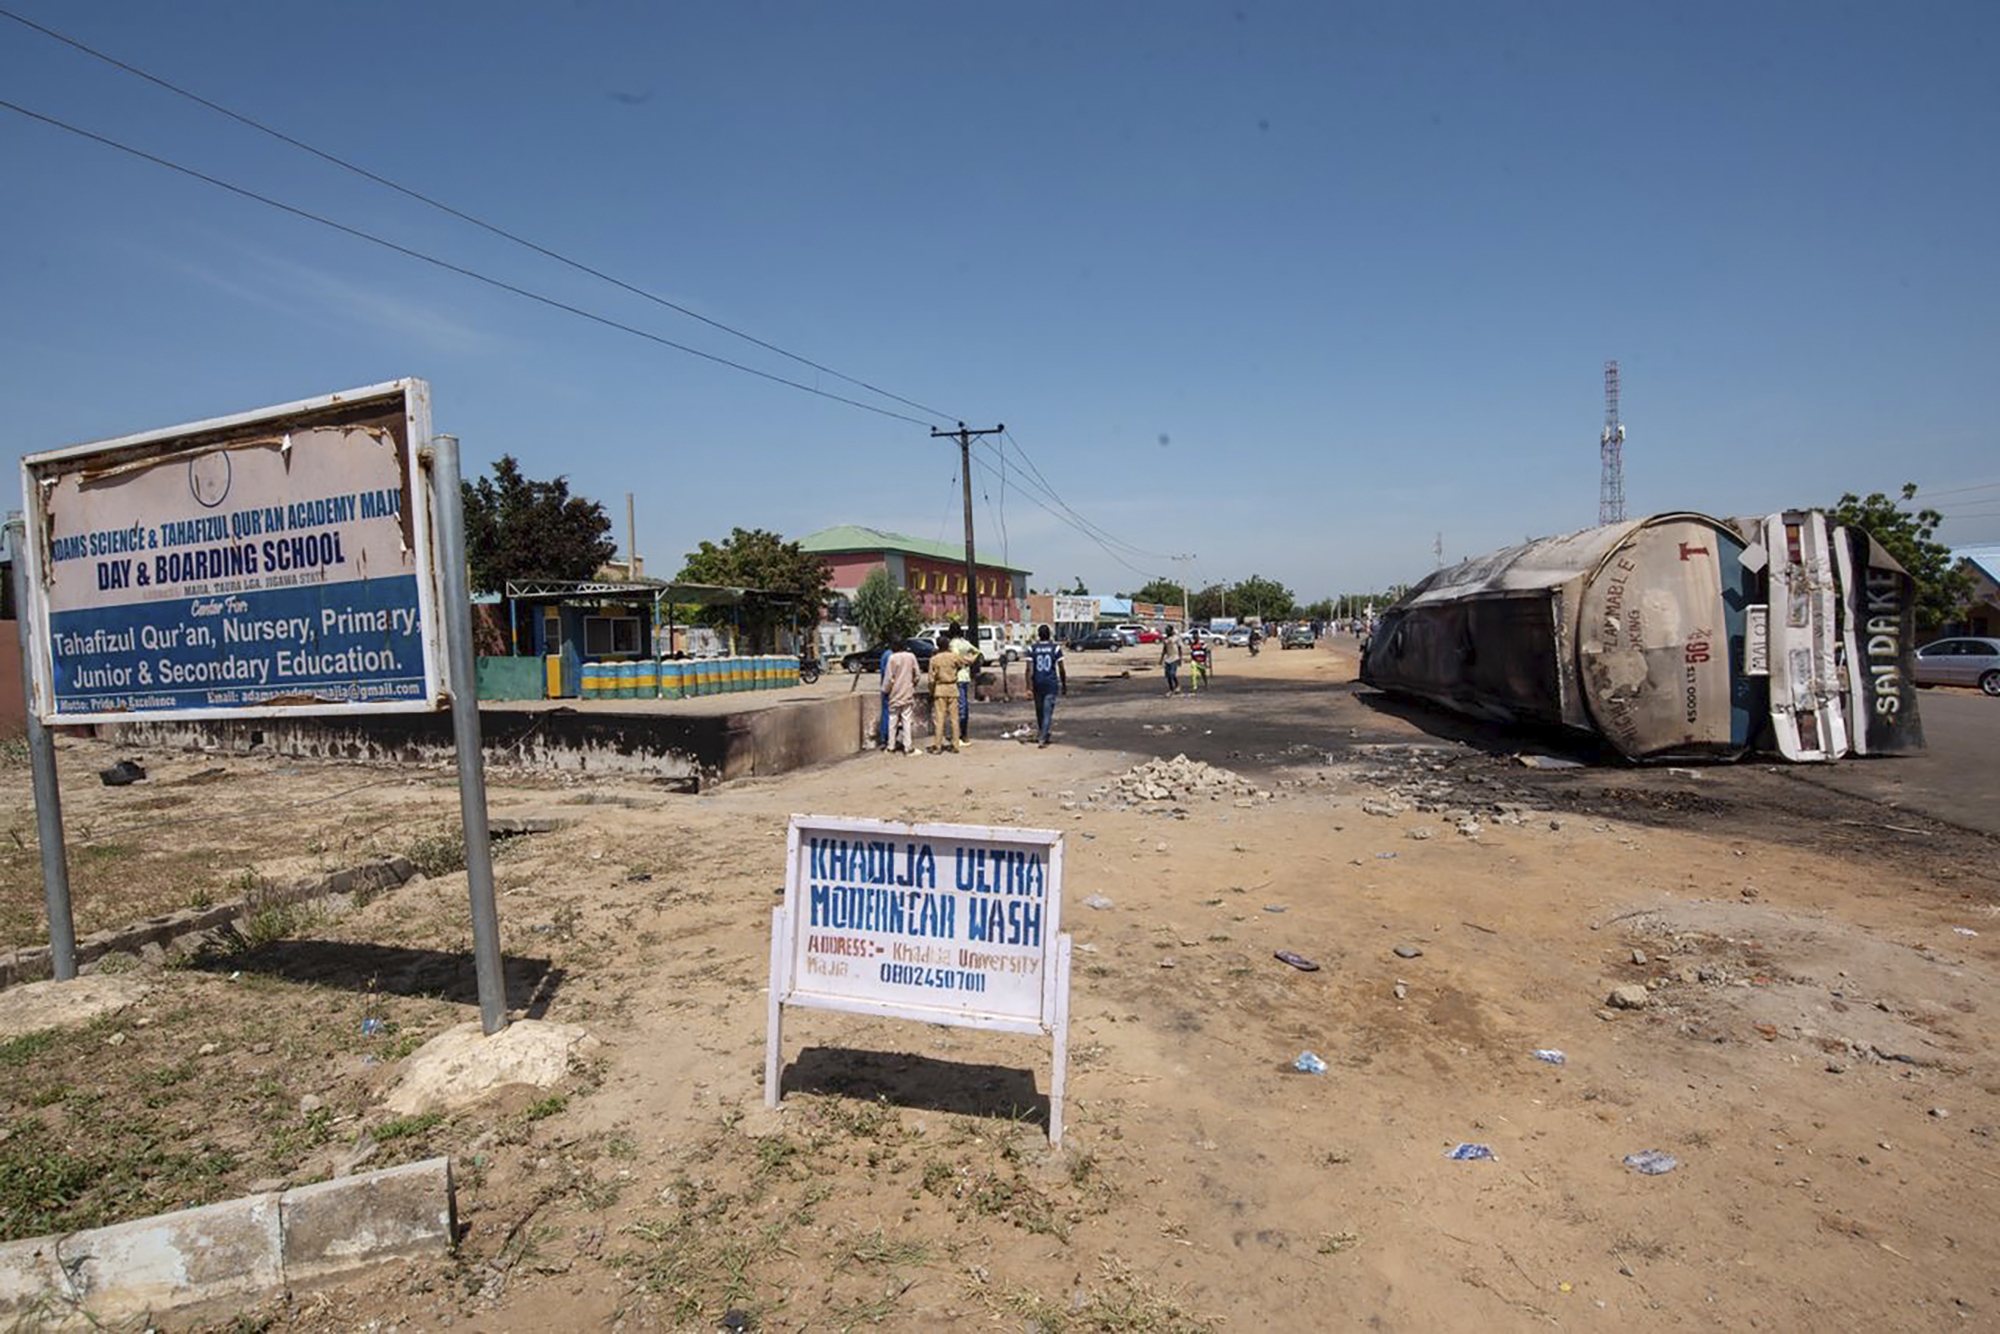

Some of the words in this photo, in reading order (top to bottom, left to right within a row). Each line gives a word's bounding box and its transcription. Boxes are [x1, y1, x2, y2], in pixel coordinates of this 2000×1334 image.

[51, 535, 87, 563] ADAMS
[90, 527, 145, 557] SCIENCE
[148, 528, 158, 550] &
[160, 514, 230, 547] TAHAFIZUL
[231, 506, 284, 540] QUR'AN
[288, 494, 356, 530] ACADEMY
[98, 559, 132, 591] DAY
[137, 561, 150, 587] &
[155, 542, 258, 584] BOARDING
[263, 531, 345, 573] SCHOOL
[53, 626, 136, 657] Tahafizul
[140, 622, 217, 651] Qur'an,
[223, 616, 316, 644] Nursery,
[321, 606, 422, 637] Primary,
[1685, 642, 1710, 664] 56
[73, 663, 132, 689] Junior
[138, 660, 153, 686] &
[159, 654, 270, 684] Secondary
[276, 645, 402, 677] Education.
[1036, 654, 1052, 672] 80
[1687, 686, 1698, 724] 45000
[810, 837, 936, 890] KHADIJA
[956, 847, 1044, 898] ULTRA
[968, 897, 1042, 948] WASH
[959, 948, 1039, 975] University
